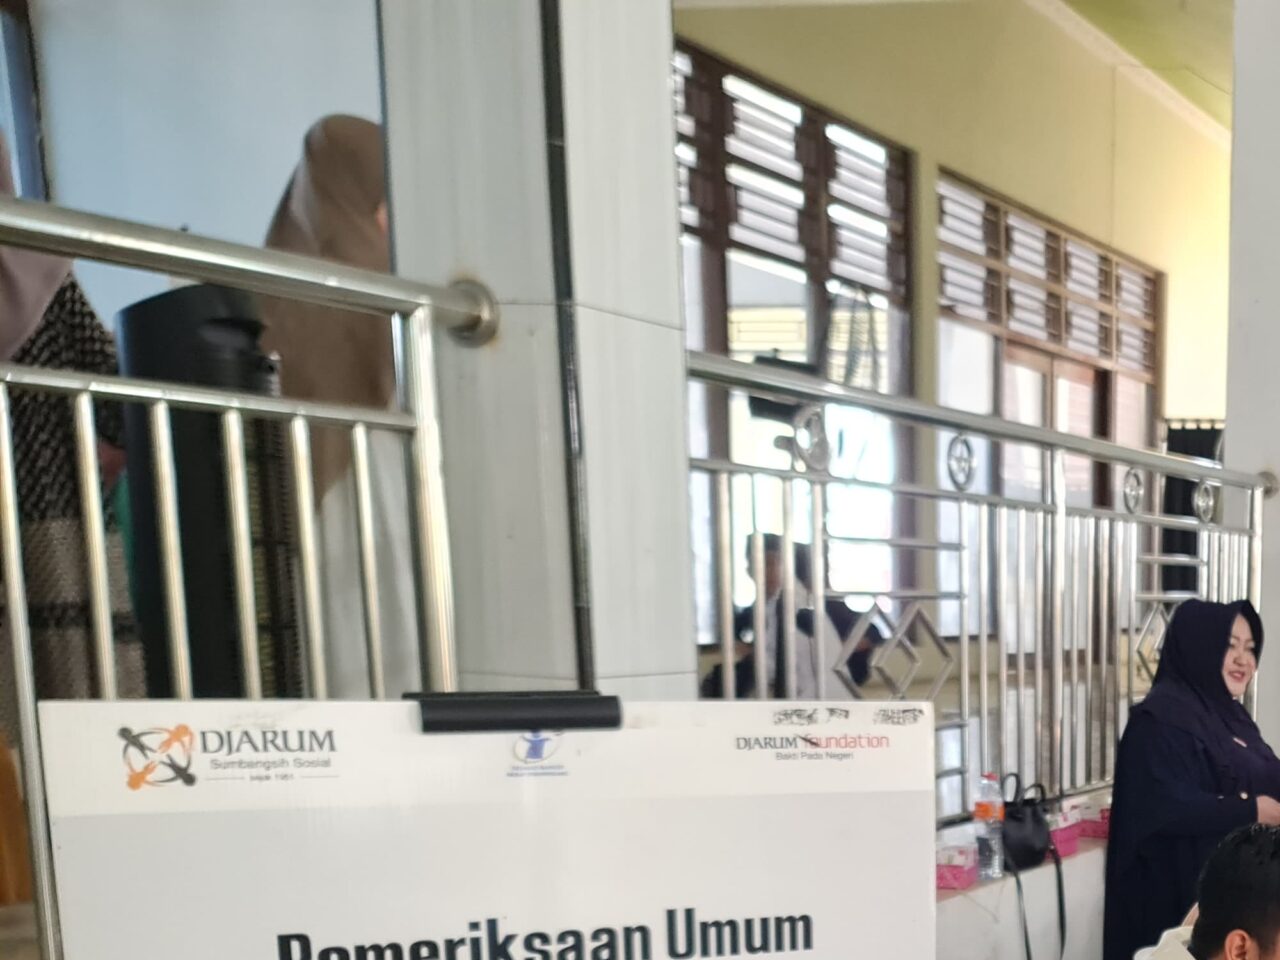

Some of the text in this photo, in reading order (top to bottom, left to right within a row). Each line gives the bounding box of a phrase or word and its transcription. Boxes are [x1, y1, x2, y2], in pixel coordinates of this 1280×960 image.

[200, 730, 336, 756] DJARUM
[736, 733, 890, 751] DJARUM foundation
[800, 751, 823, 760] Pada
[825, 751, 854, 762] Negeri
[665, 907, 813, 960] Umum
